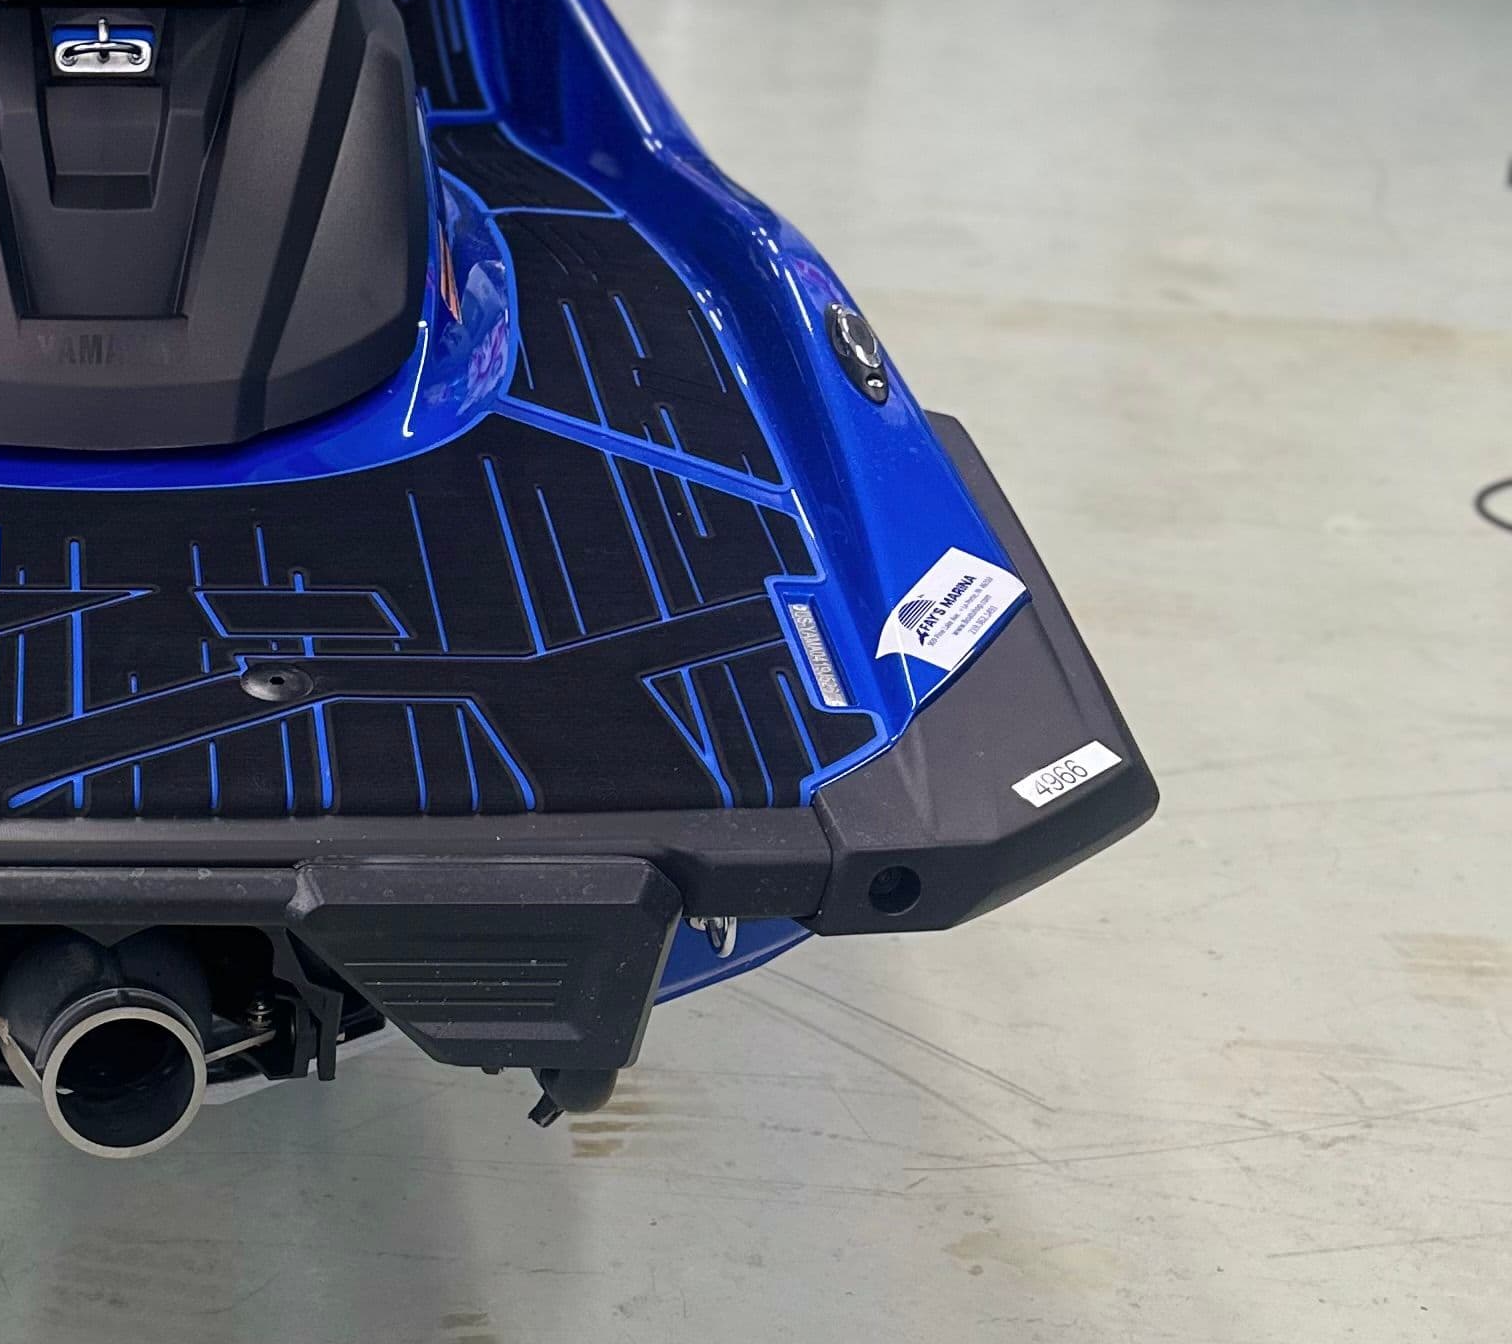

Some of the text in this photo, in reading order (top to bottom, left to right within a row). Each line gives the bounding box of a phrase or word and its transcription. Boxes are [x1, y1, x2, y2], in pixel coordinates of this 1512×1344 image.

[919, 575, 977, 632] FAY'S MARINA
[1035, 759, 1088, 795] 4966
